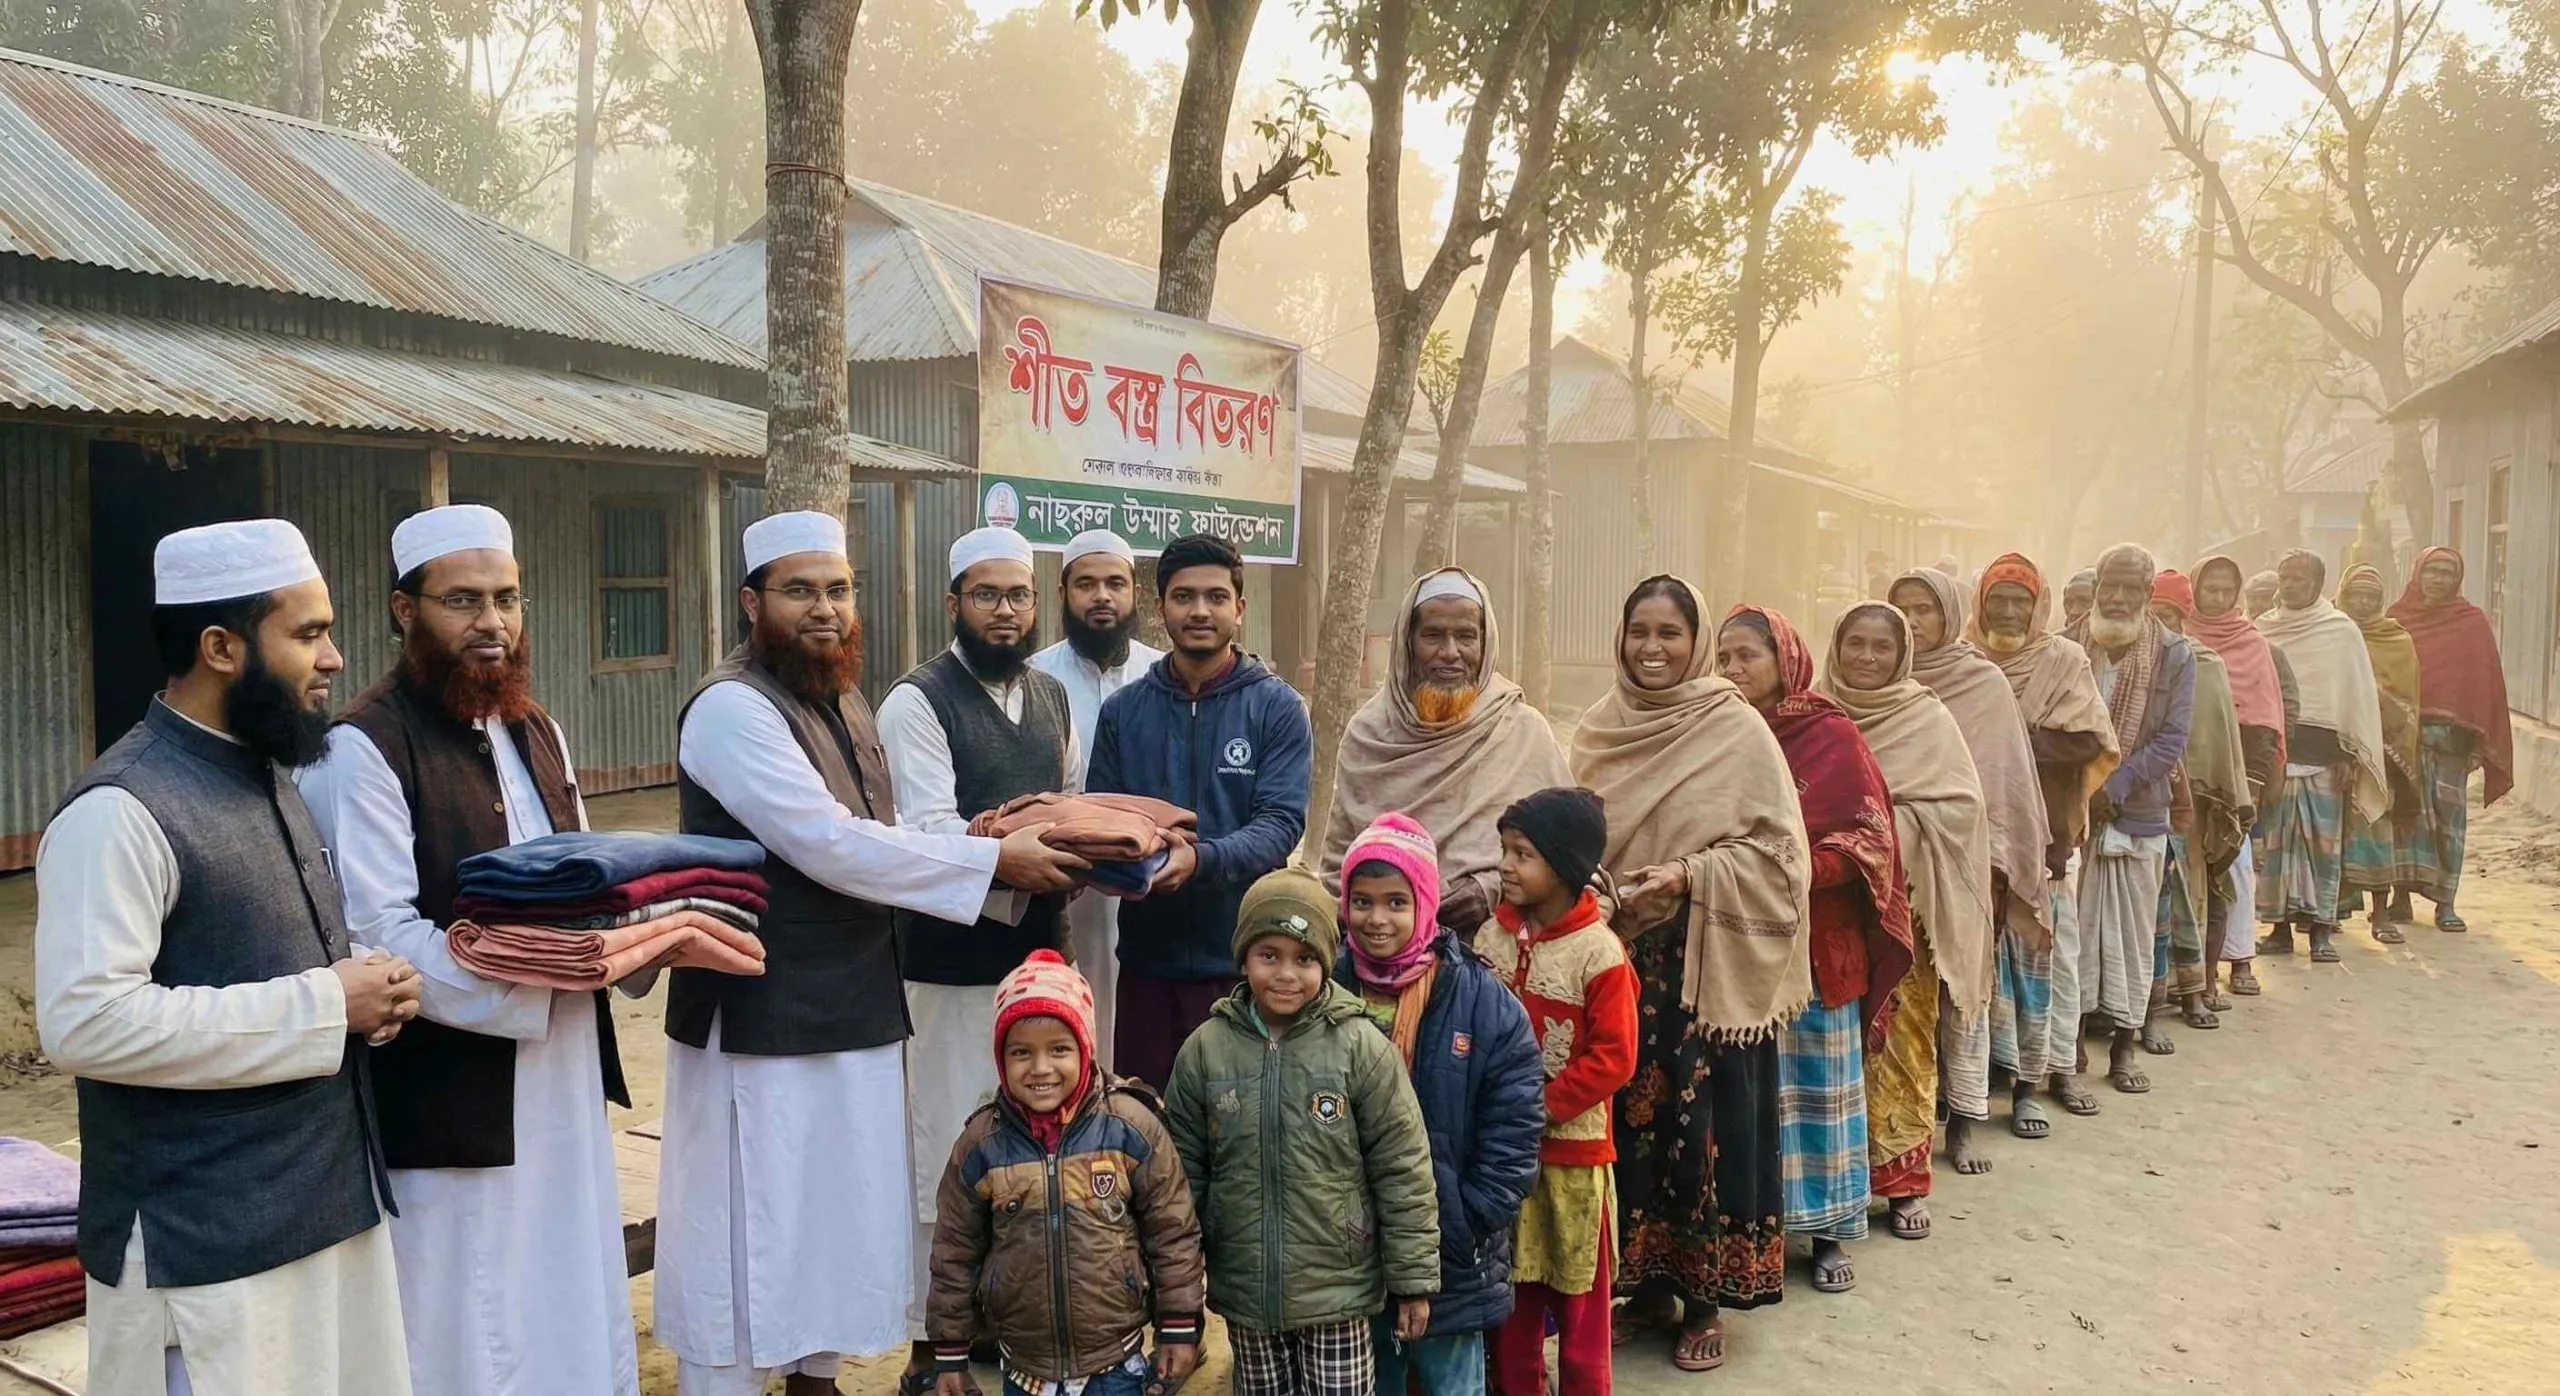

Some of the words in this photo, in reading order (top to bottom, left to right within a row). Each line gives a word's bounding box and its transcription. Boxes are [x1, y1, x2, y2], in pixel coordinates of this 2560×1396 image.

[1004, 315, 1094, 432] শীত
[1103, 364, 1165, 447] বস্ত্র
[1174, 352, 1280, 457] বিতরণ
[1121, 492, 1183, 542] উম্মাহ
[1189, 502, 1284, 548] ফাউন্ডেশন
